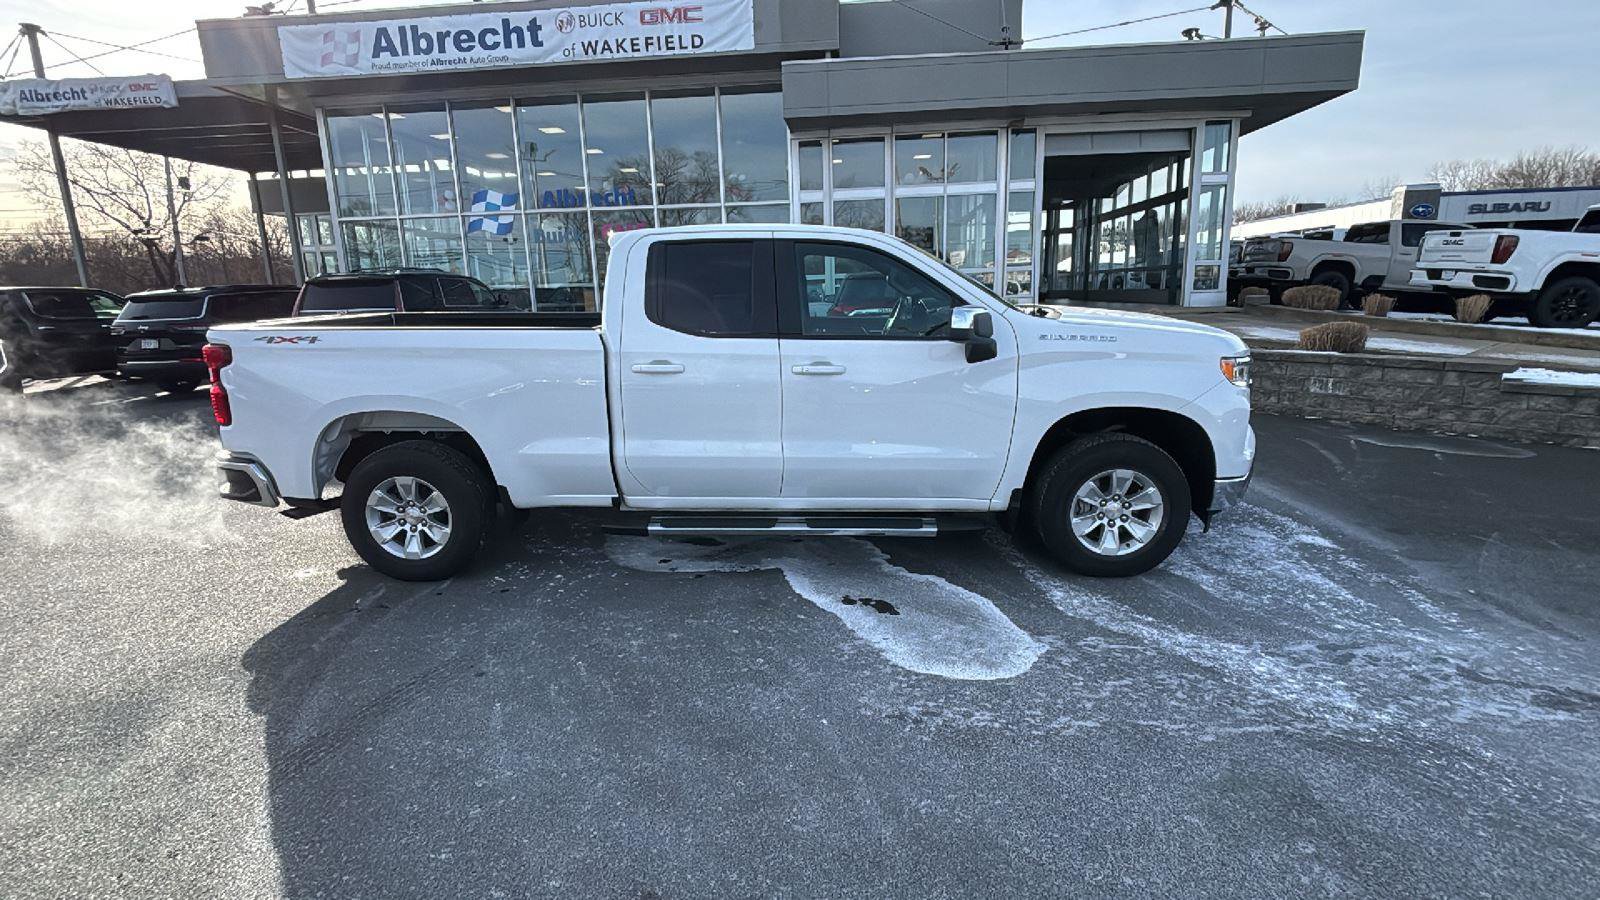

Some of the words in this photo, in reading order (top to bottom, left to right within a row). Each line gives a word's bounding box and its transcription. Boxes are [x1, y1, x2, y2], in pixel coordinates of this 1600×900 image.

[578, 11, 624, 28] BUICK
[639, 5, 704, 26] GMC
[371, 17, 544, 59] Albrecht
[562, 42, 576, 58] of
[581, 34, 704, 56] WAKEFIELD
[371, 62, 391, 71] Proud
[393, 60, 420, 70] member
[421, 59, 429, 68] of
[430, 56, 467, 67] Albrecht
[469, 56, 485, 65] Auto
[486, 54, 509, 64] Group
[19, 87, 88, 103] Albrecht
[104, 96, 162, 107] WAKEFIELD
[1468, 201, 1551, 214] SUBARU
[1039, 334, 1118, 342] SILVERADO
